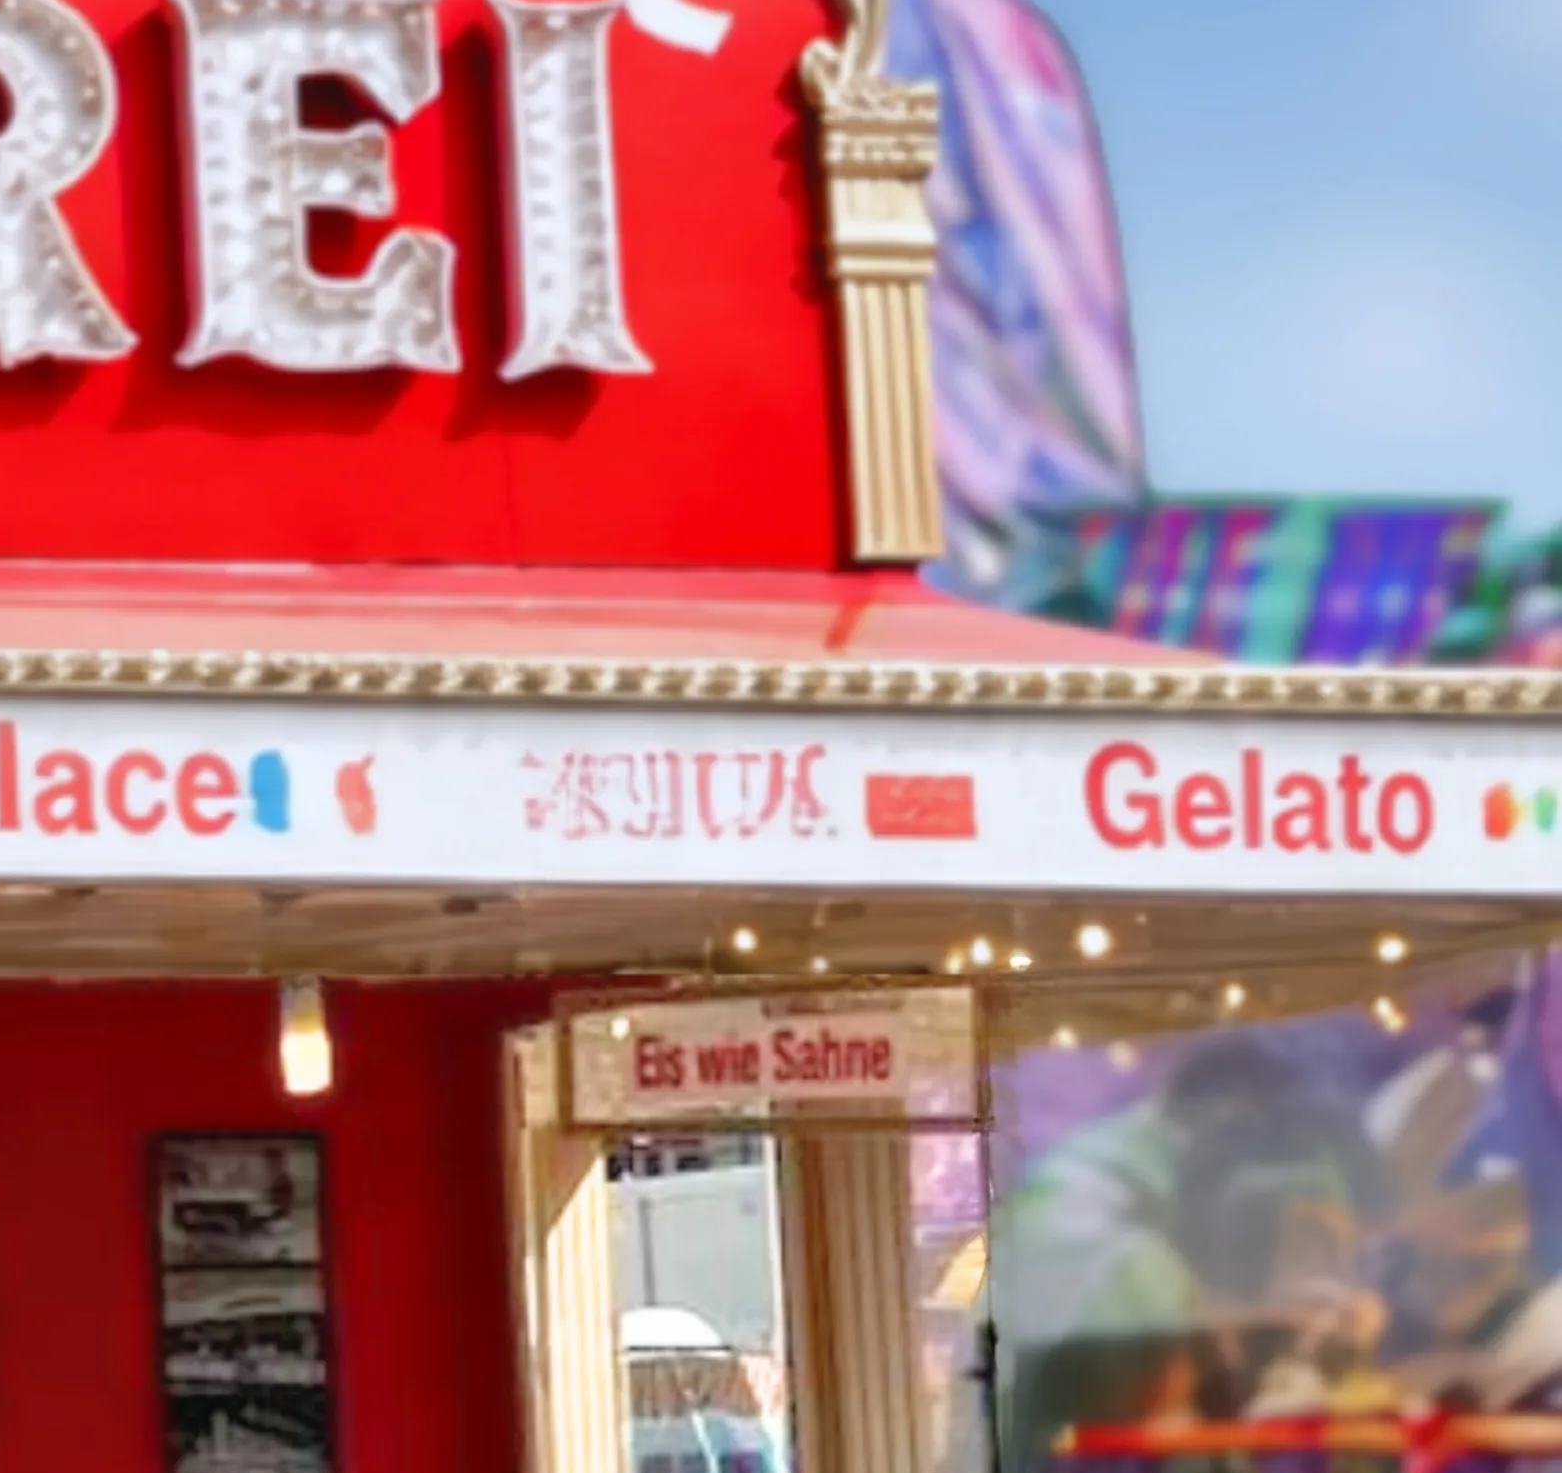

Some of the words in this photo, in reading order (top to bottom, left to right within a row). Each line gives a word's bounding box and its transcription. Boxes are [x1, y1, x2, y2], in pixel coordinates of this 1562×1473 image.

[1083, 740, 1435, 855] Gelato
[634, 1034, 685, 1089] Eis
[697, 1035, 761, 1084] wie
[772, 1030, 891, 1084] Sahne
